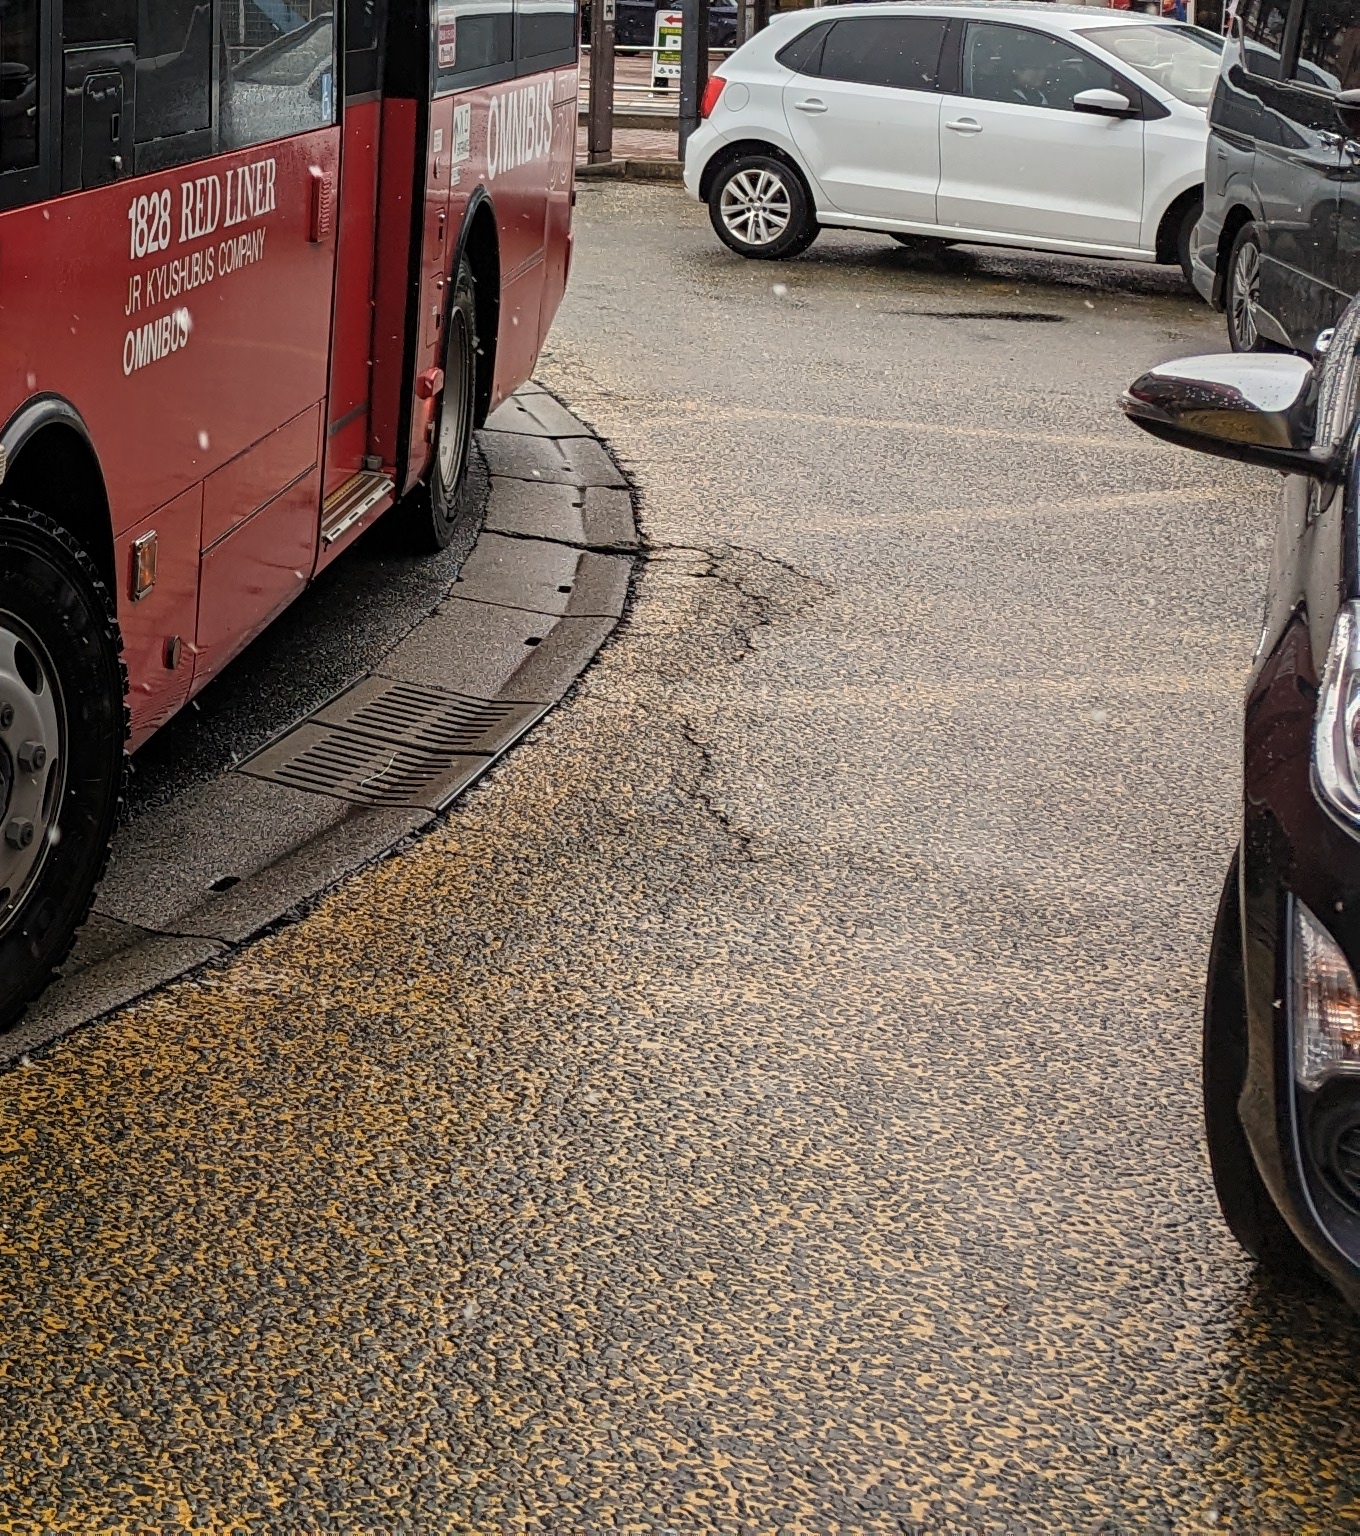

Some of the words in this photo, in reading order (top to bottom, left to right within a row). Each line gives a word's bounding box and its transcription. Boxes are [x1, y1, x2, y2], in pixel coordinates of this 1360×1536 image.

[487, 79, 553, 180] OMNIBUS
[128, 189, 172, 260] 1828
[179, 175, 221, 243] RED
[223, 158, 277, 228] LINER
[125, 274, 141, 316] JR
[146, 246, 215, 308] KYUSHUBUS
[218, 227, 267, 277] COMPANY
[123, 306, 190, 376] OMNIBUS
